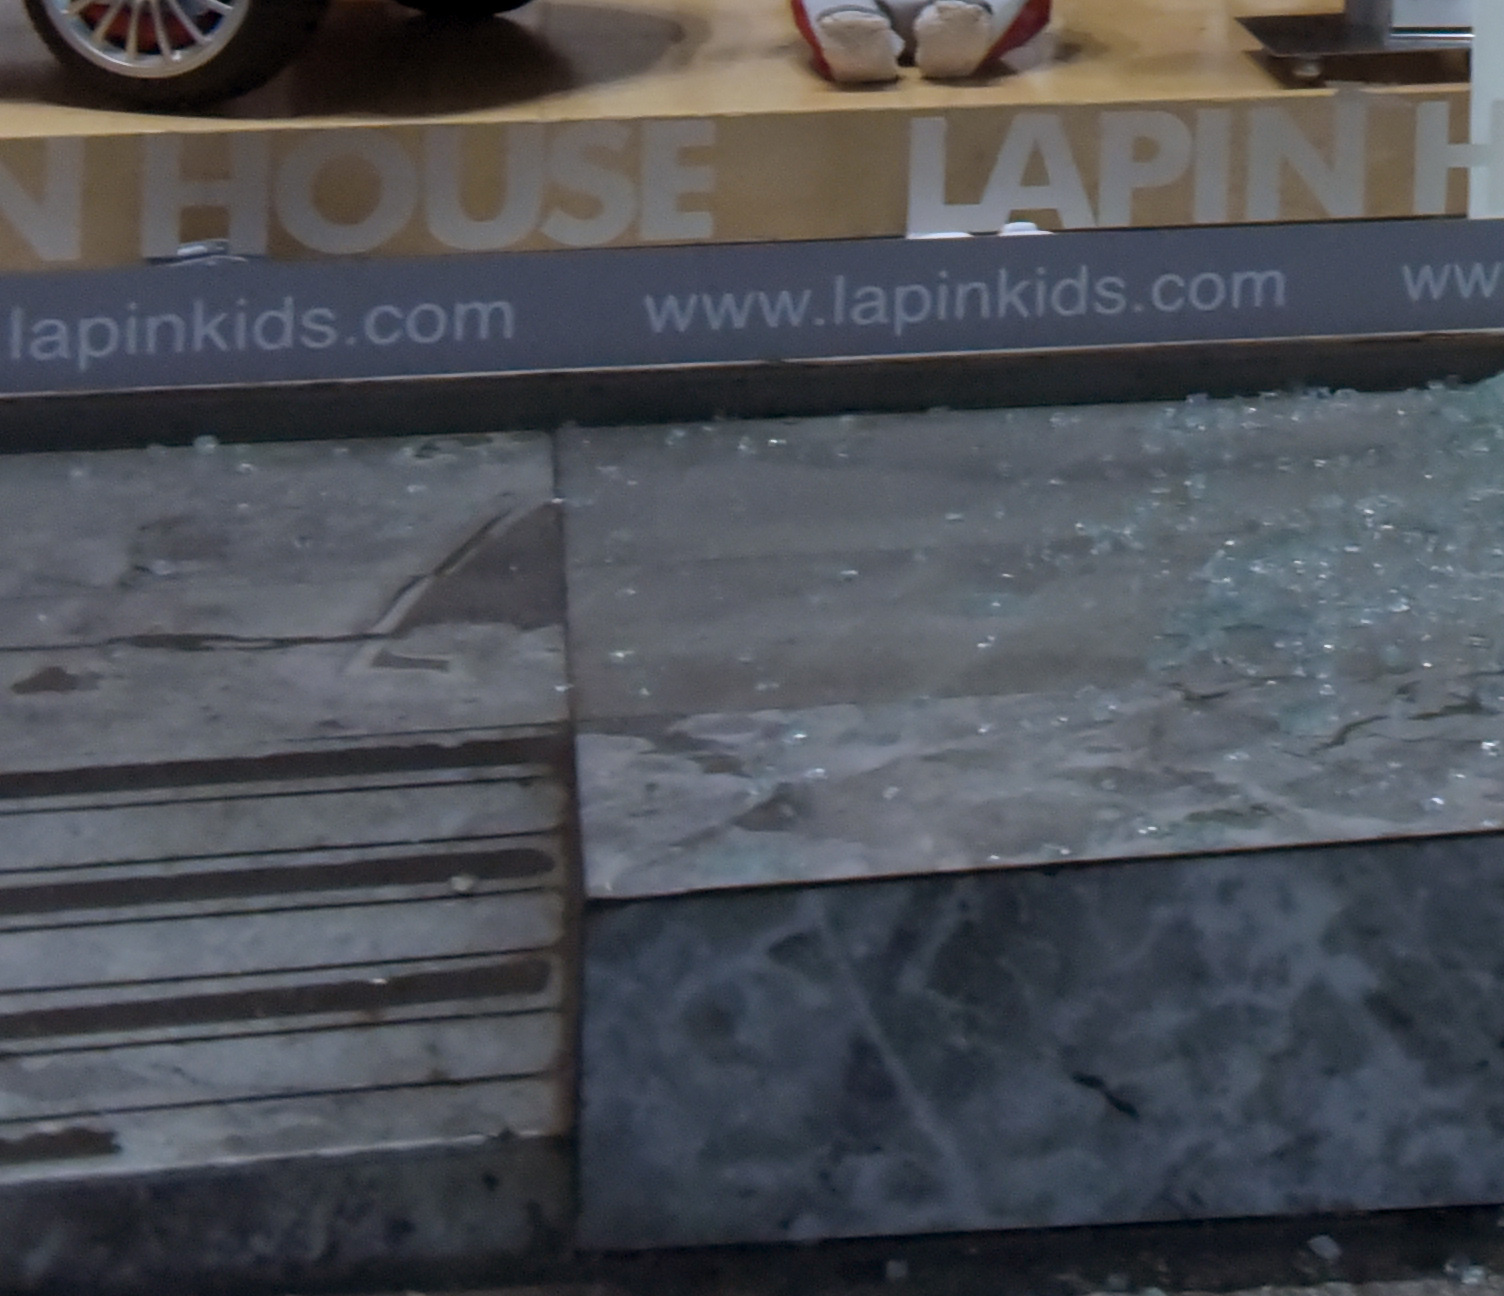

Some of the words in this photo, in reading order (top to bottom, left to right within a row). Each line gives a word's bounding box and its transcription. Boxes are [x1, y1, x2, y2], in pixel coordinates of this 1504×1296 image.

[141, 119, 718, 259] HOUSE
[906, 105, 1368, 236] LAPIN
[9, 297, 516, 371] lapinkids.com
[645, 265, 1286, 336] www.lapinkids.com
